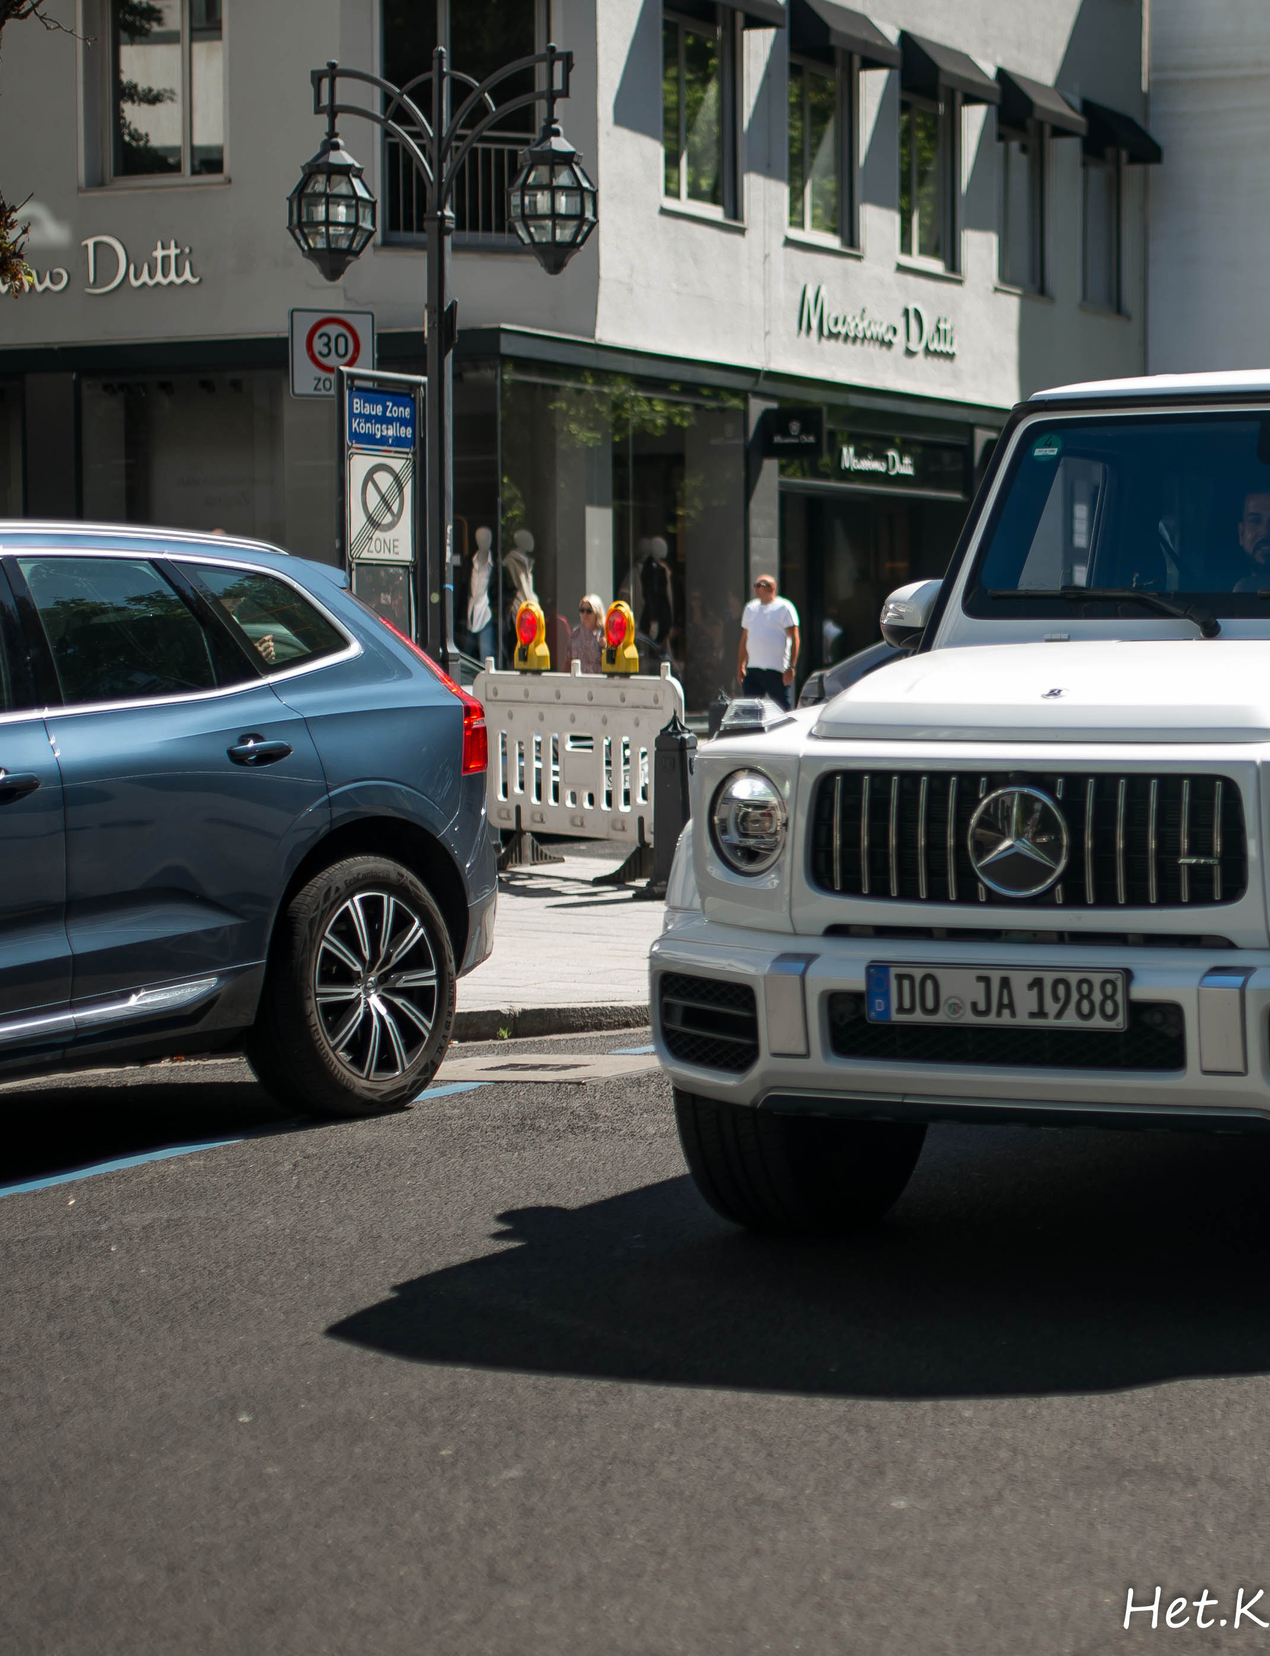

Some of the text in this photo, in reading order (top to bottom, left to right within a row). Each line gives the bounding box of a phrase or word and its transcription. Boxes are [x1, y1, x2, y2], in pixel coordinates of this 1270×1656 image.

[81, 234, 201, 294] Dutti
[798, 283, 957, 361] Massimo Dutti
[318, 332, 349, 359] 30
[313, 376, 333, 392] ZO
[353, 398, 411, 419] Blaue Zone
[351, 417, 413, 439] Königsallee
[1044, 435, 1053, 447] 4
[841, 444, 915, 476] Massimo Dutti
[366, 536, 400, 555] ZONE
[876, 973, 1120, 1022] D DO JA 1988
